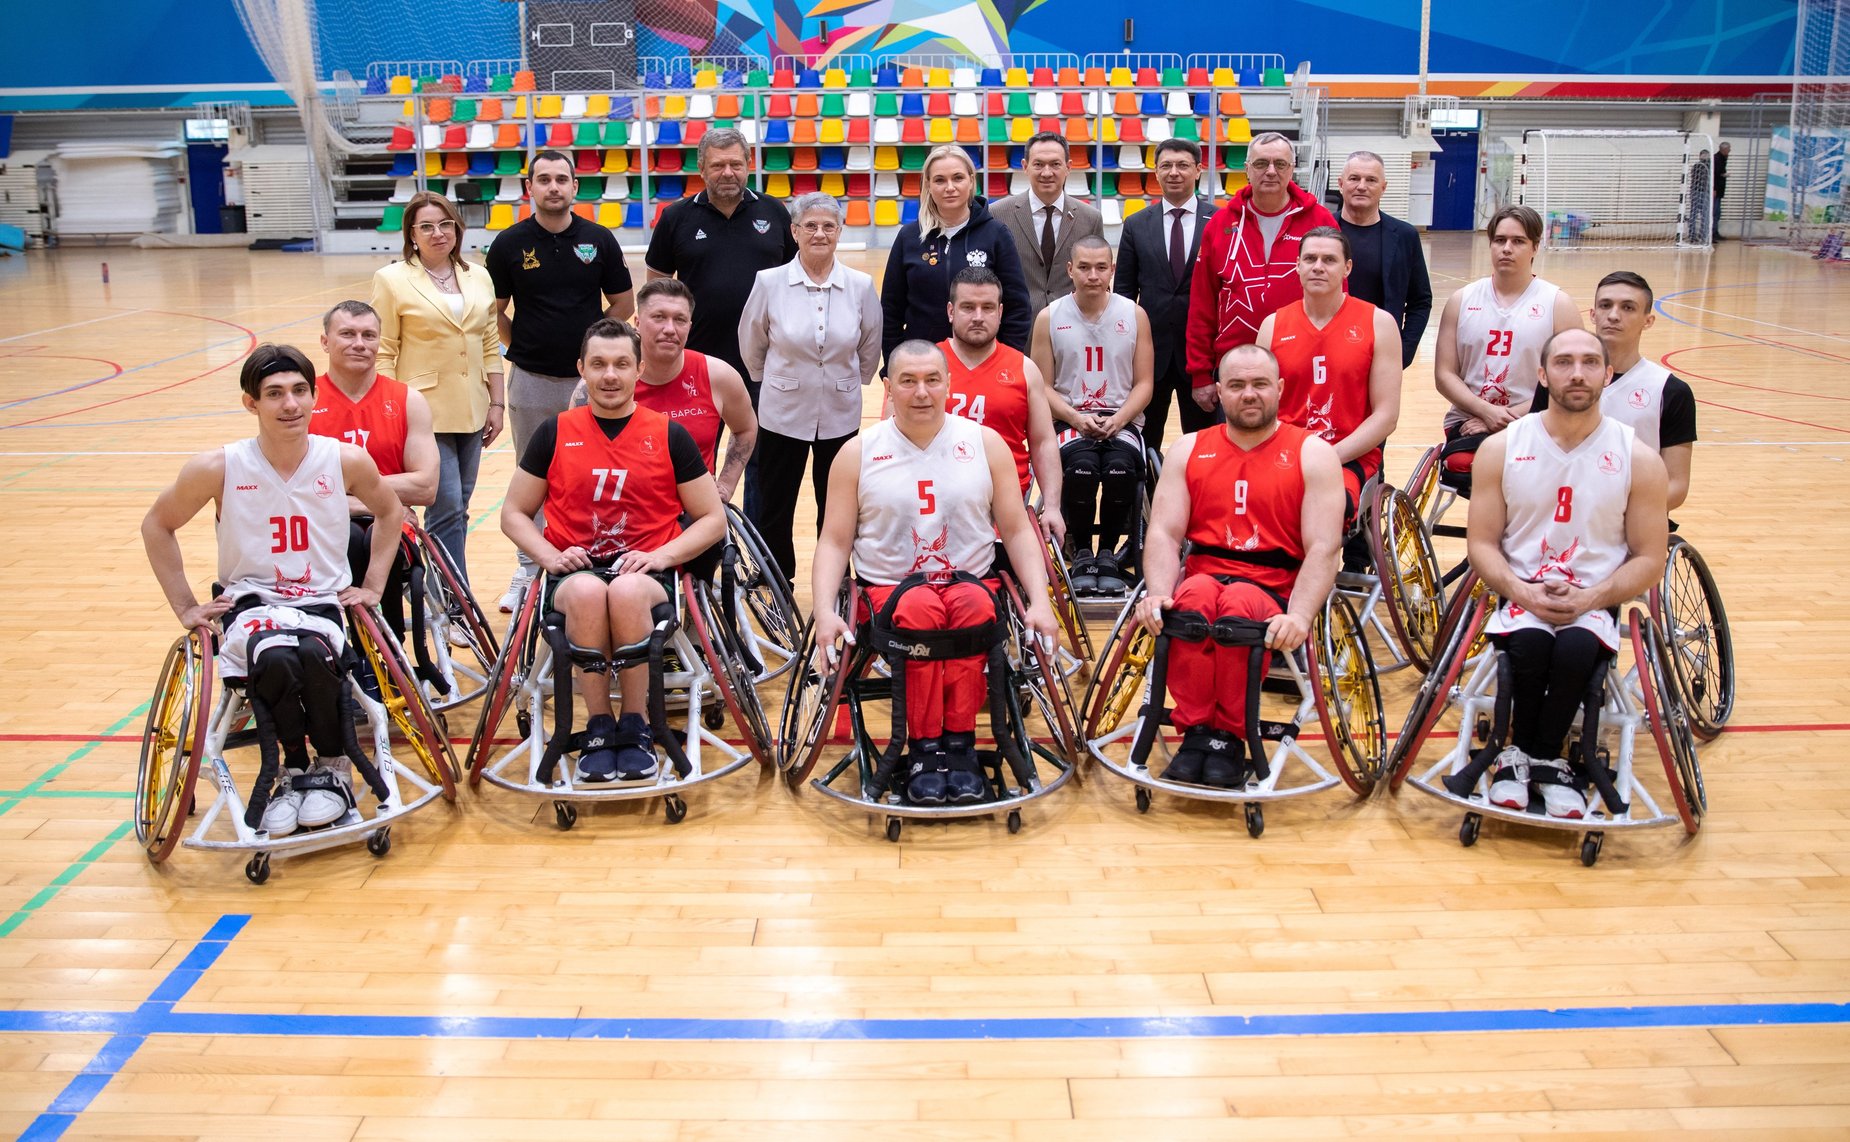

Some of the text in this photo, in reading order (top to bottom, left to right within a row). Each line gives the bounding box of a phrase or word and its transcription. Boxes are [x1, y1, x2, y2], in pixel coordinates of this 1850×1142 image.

[624, 29, 633, 39] G
[1085, 346, 1104, 372] 11
[1486, 329, 1514, 357] 23
[1312, 355, 1327, 385] 6
[952, 393, 986, 425] 24
[872, 454, 894, 462] MAXX
[592, 468, 629, 502] 77
[917, 480, 936, 516] 5
[1234, 480, 1249, 515] 9
[1554, 486, 1574, 523] 8
[269, 515, 310, 554] 30
